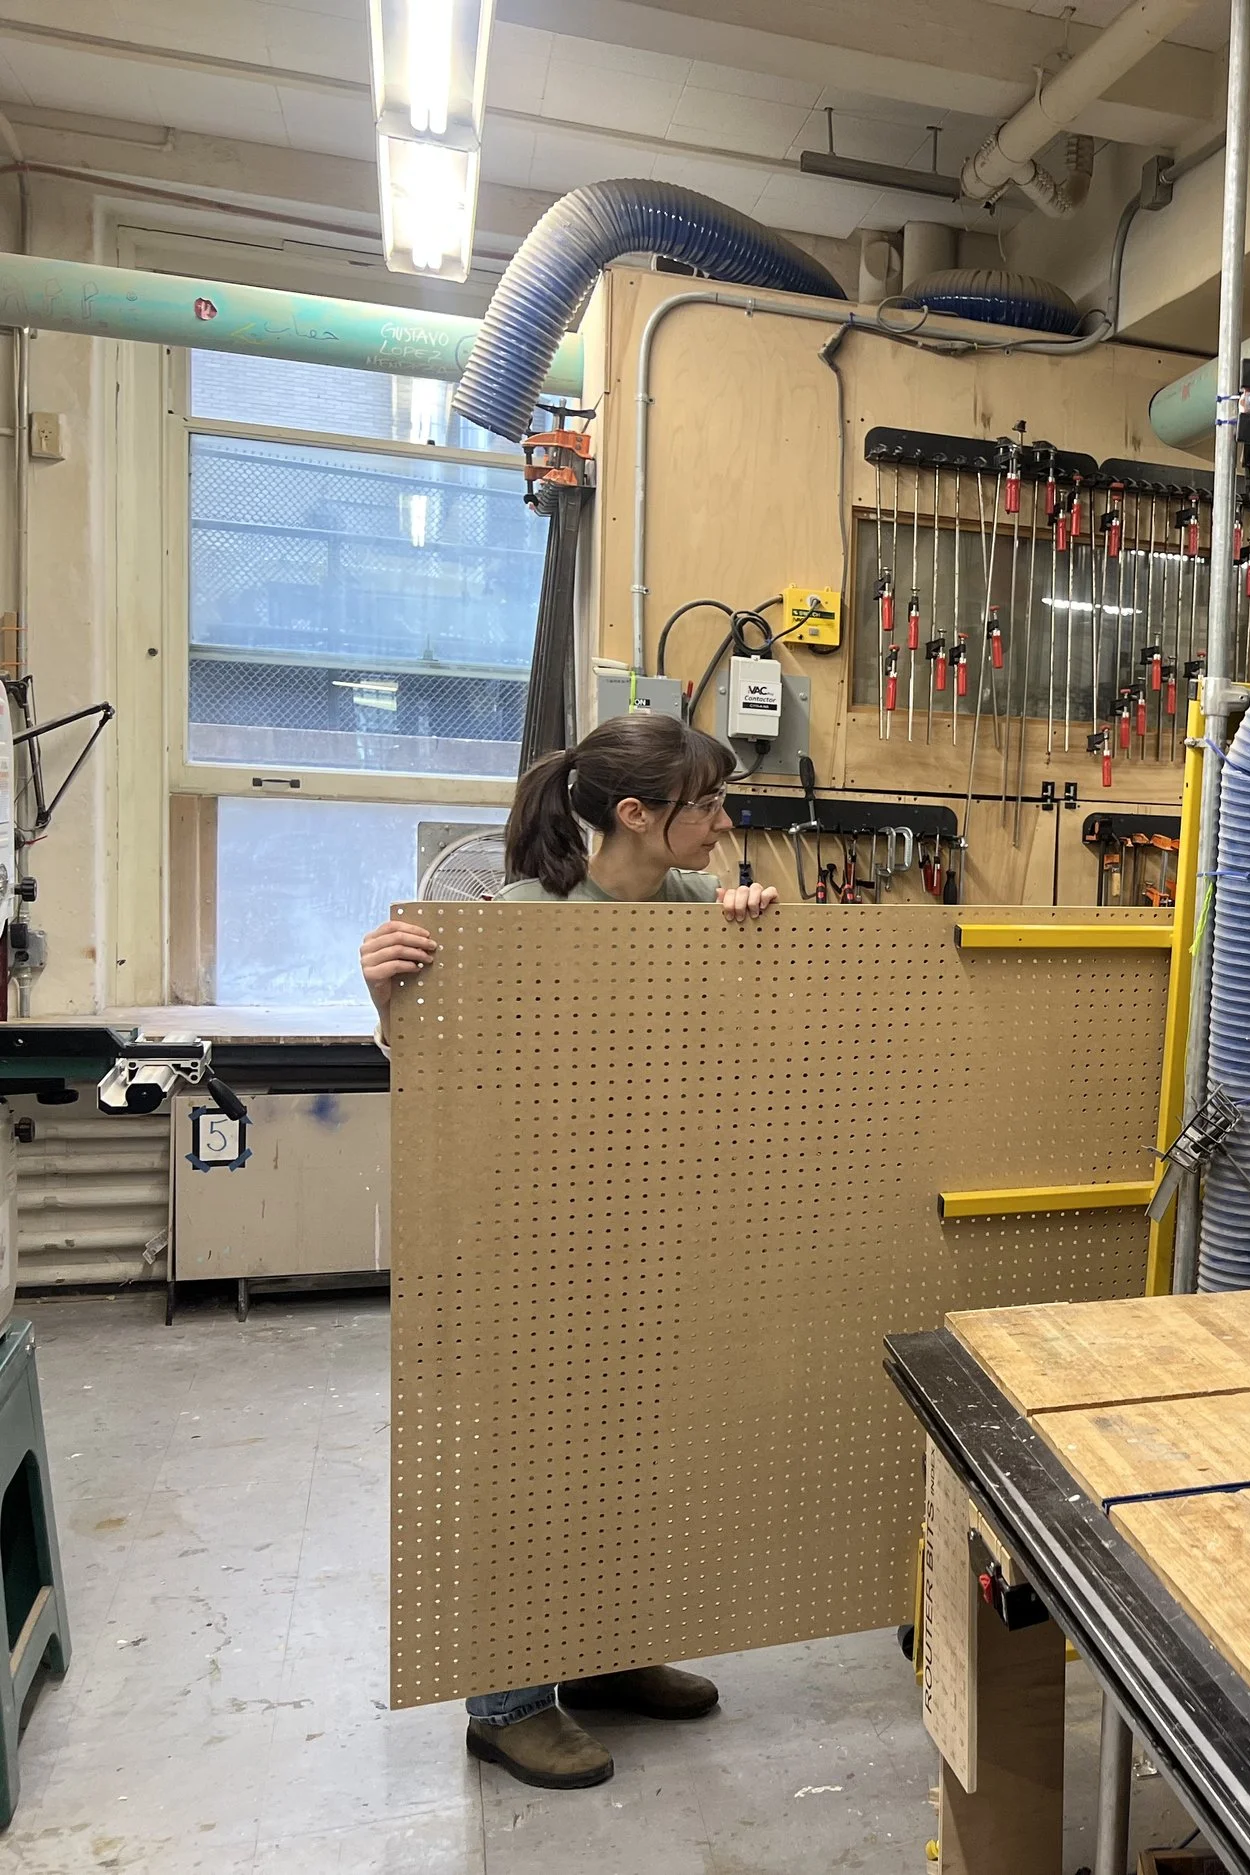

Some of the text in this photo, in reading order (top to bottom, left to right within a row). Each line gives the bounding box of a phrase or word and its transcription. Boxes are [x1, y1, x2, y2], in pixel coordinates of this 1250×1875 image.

[381, 321, 450, 347] GUSTAVO
[380, 340, 442, 363] LOPEZ
[744, 695, 777, 703] Contactor
[207, 1118, 228, 1151] 5
[926, 1500, 936, 1572] BITS
[925, 1579, 934, 1714] ROUTER
